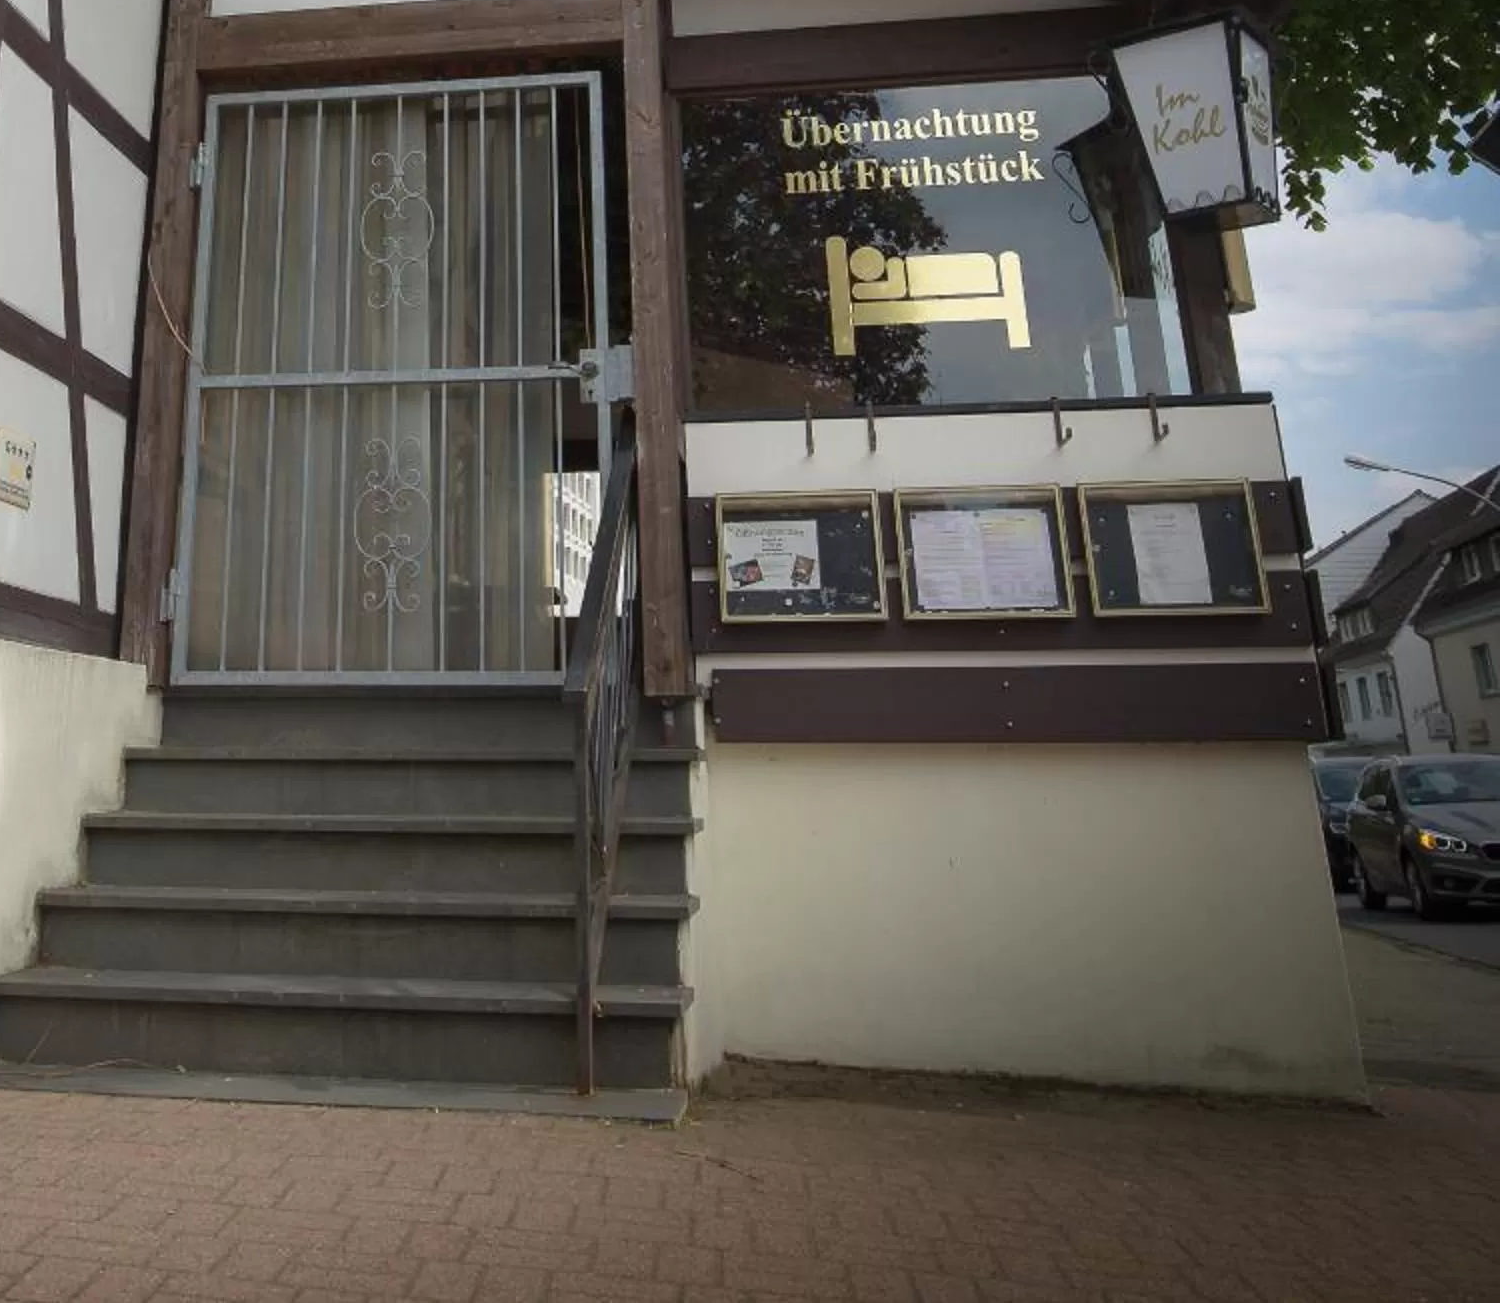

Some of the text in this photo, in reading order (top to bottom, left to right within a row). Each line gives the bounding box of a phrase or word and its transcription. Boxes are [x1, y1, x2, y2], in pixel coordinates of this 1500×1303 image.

[1156, 83, 1199, 117] Im
[780, 108, 1040, 148] Übernachtung
[1153, 105, 1227, 154] Kohl
[785, 151, 1044, 194] mit Frühstück
